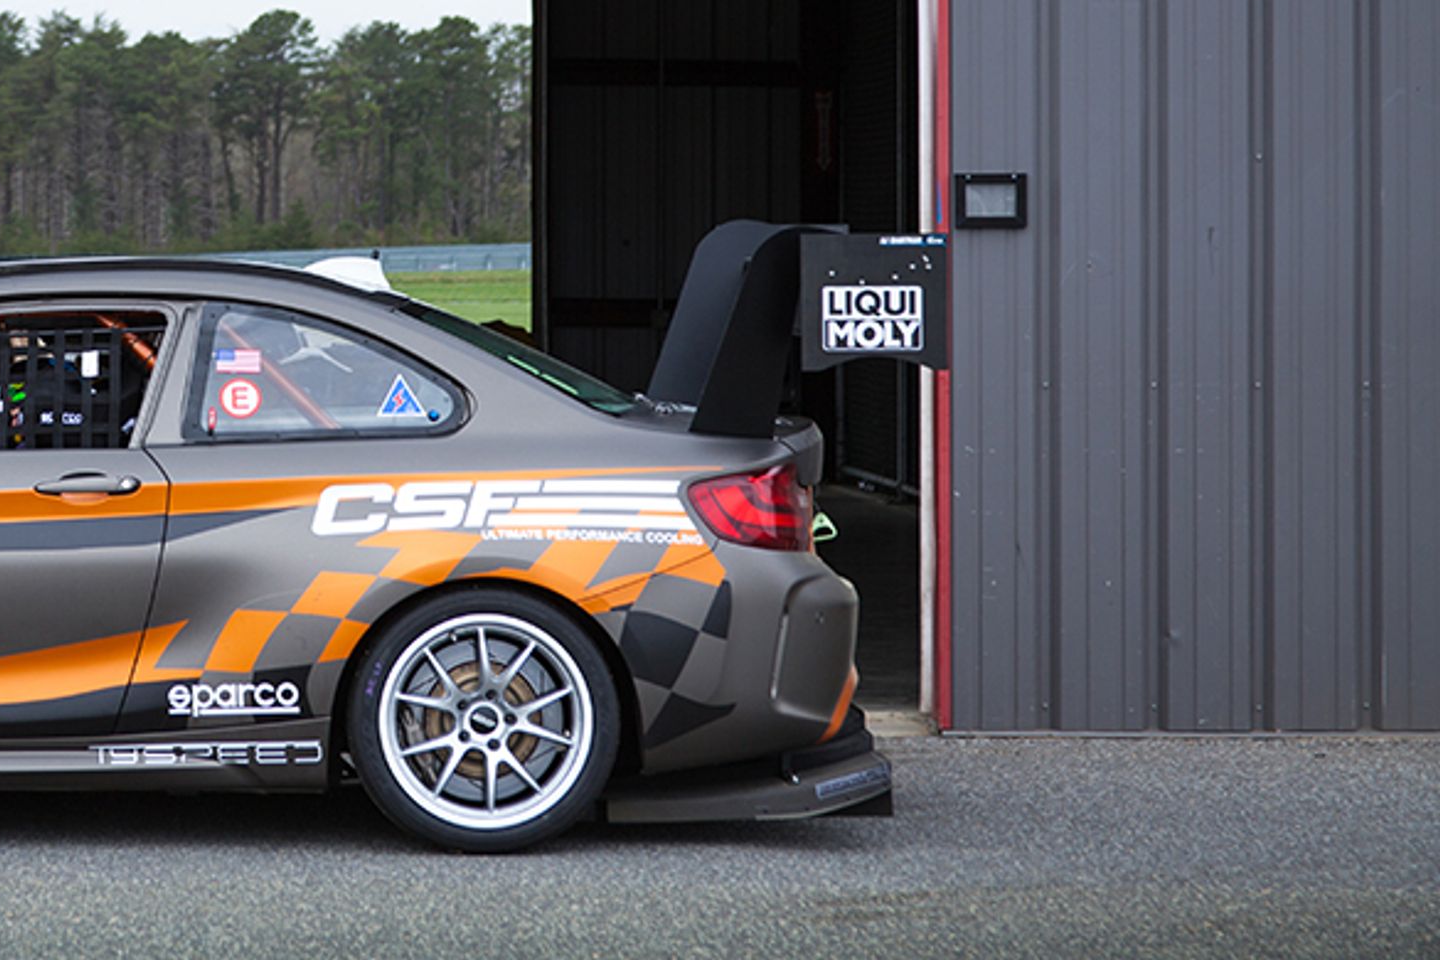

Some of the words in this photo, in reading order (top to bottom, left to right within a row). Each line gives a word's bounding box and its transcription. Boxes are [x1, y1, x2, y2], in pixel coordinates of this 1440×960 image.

[828, 290, 916, 316] LIQUI
[827, 320, 919, 348] MOLY
[231, 386, 249, 410] E
[311, 480, 542, 536] CSF
[480, 528, 544, 541] ULTIMATE
[546, 528, 643, 544] PERFORMANCE
[645, 531, 704, 546] COOLING
